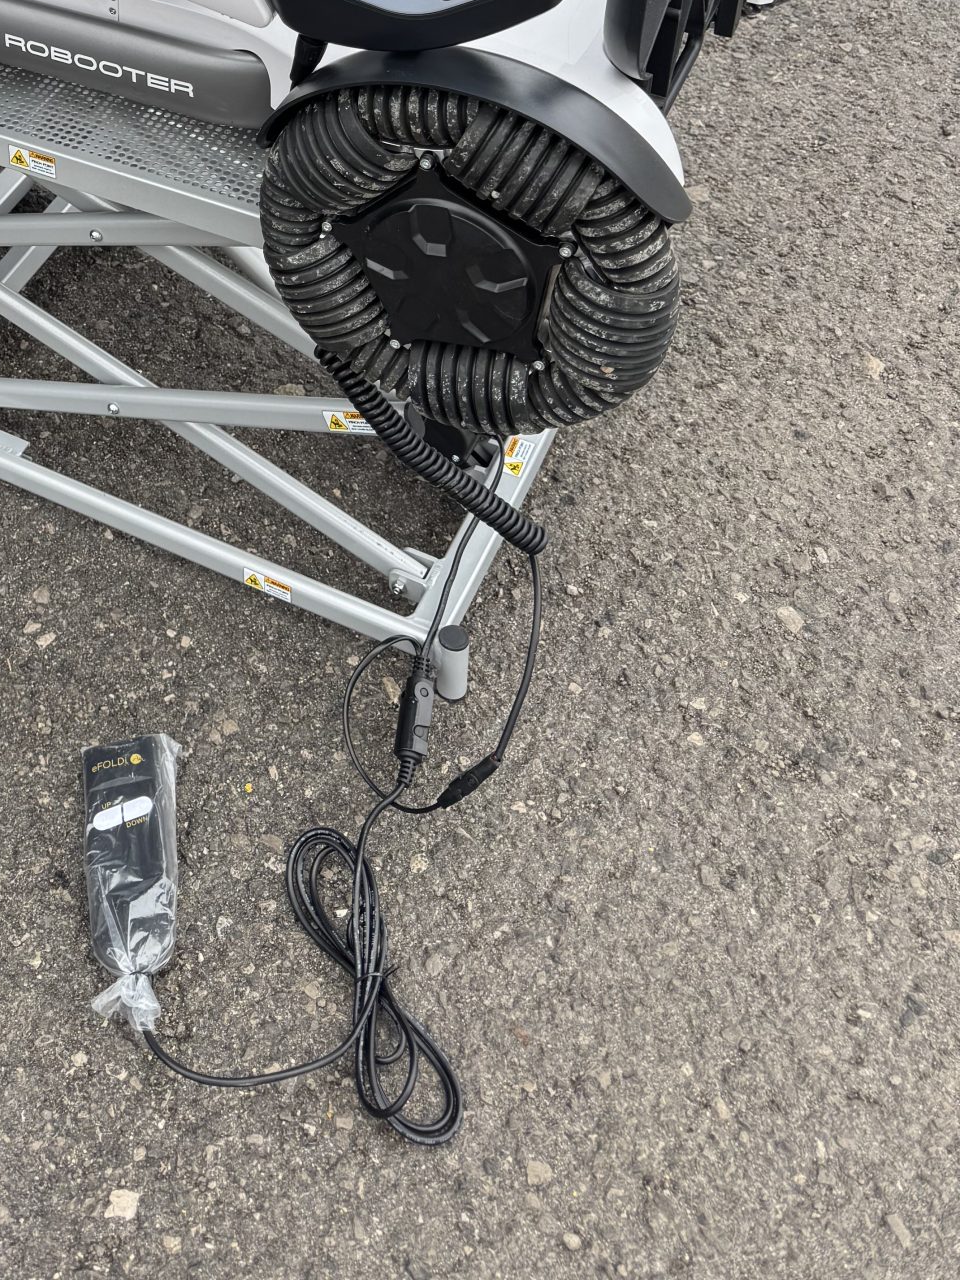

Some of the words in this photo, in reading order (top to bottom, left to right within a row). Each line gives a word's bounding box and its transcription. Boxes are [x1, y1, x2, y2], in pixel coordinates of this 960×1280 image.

[4, 33, 194, 98] ROBOOTER
[101, 801, 112, 810] UP
[126, 816, 148, 828] DOWN
